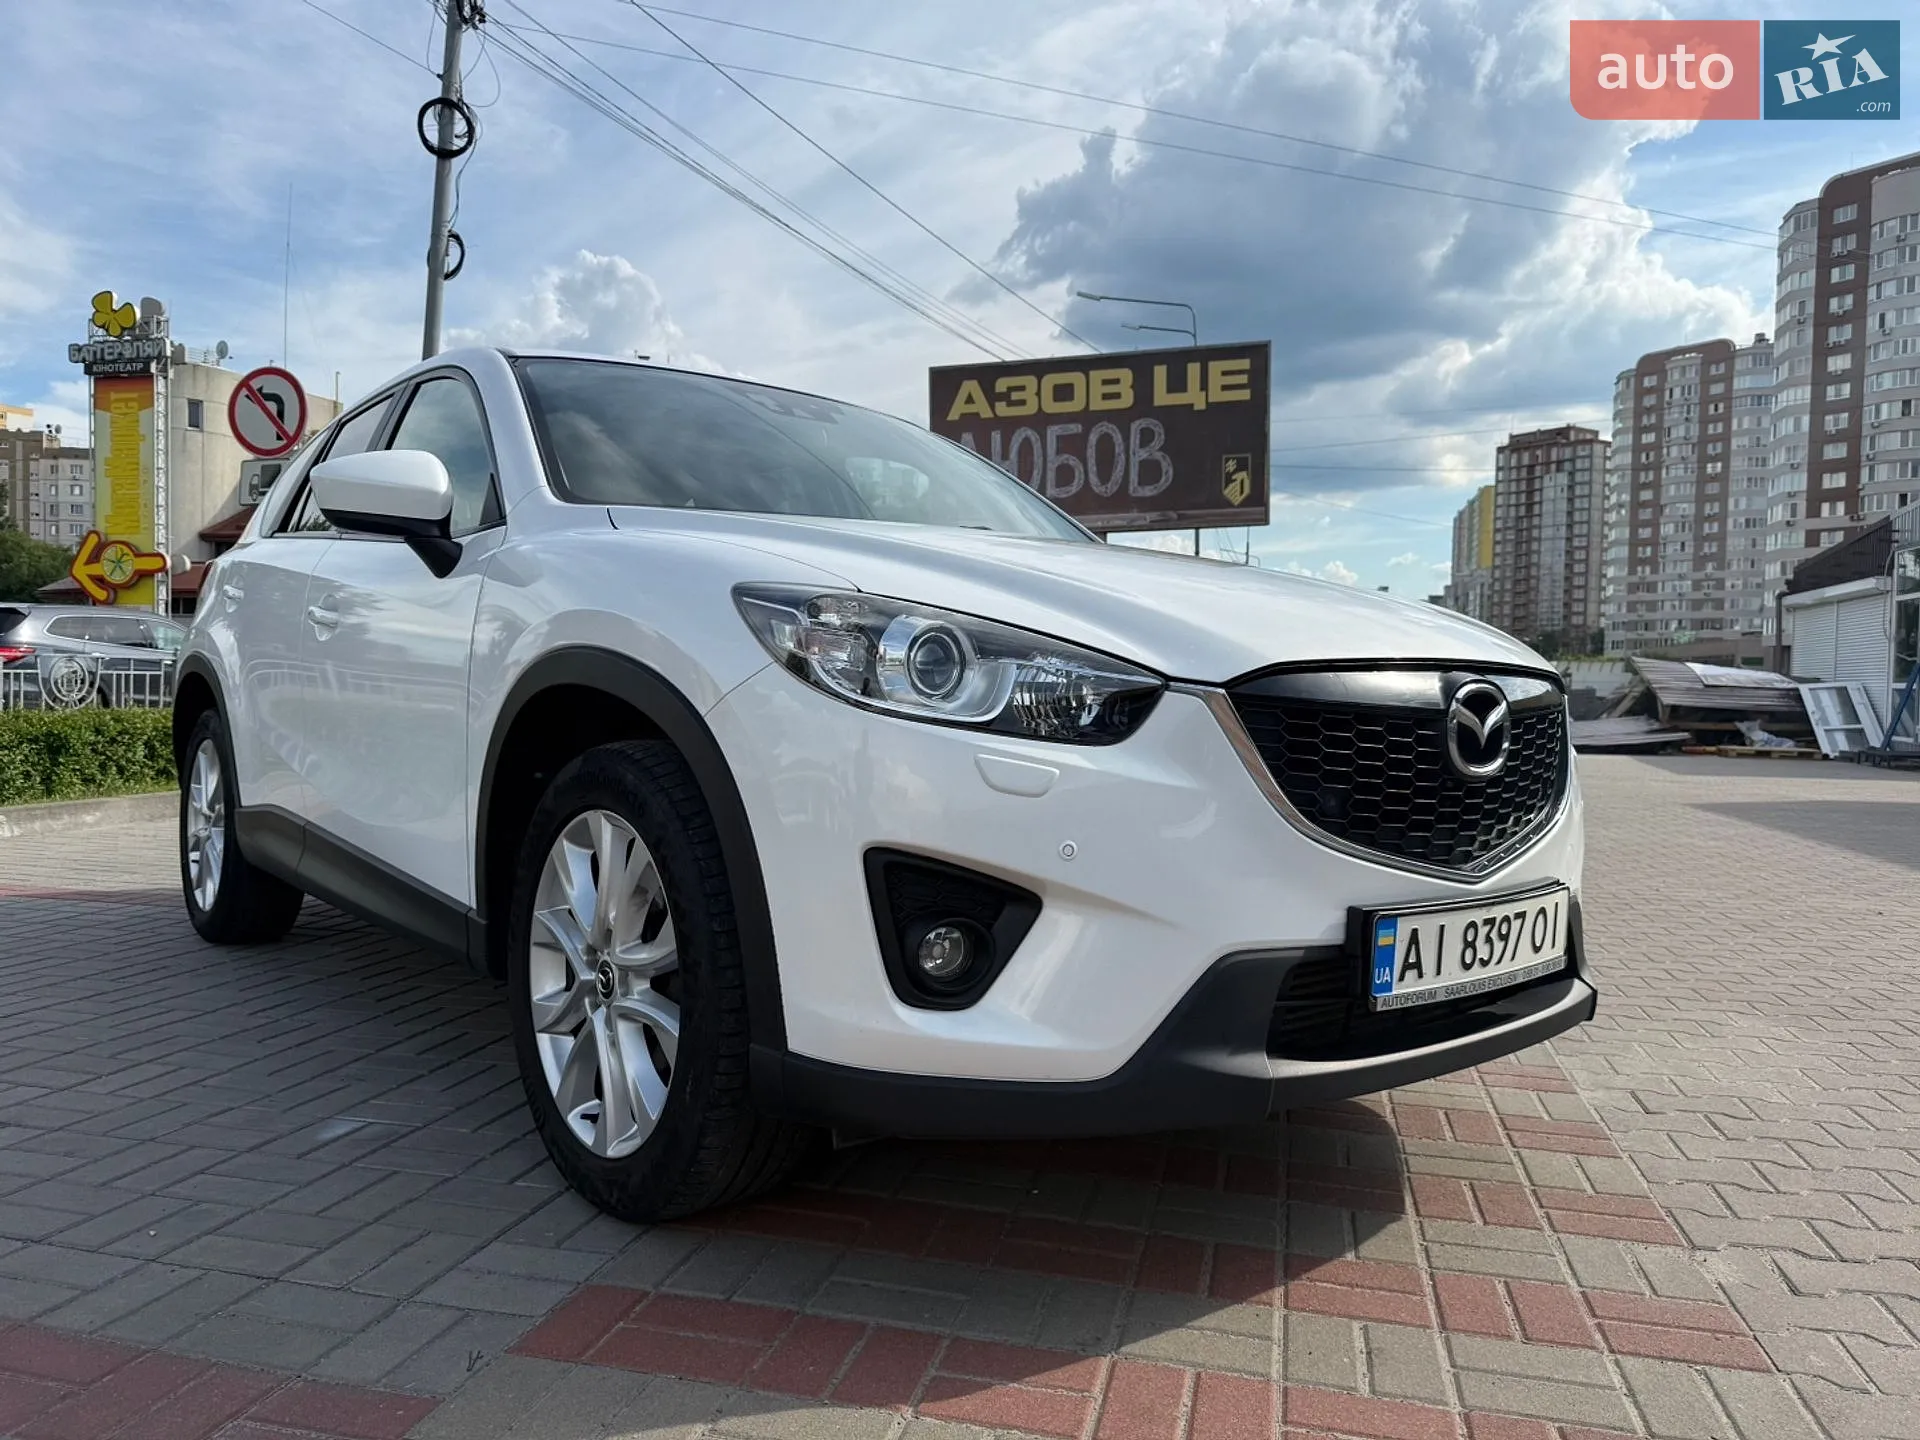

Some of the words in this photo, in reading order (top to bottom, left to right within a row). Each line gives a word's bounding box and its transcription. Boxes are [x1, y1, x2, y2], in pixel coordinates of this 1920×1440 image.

[92, 362, 144, 373] КІНОТЕАТР
[946, 367, 1134, 421] АЗОВ
[1153, 358, 1251, 411] ЦЕ
[1398, 924, 1446, 982] AI
[1461, 910, 1527, 971] 8397
[1374, 966, 1391, 984] UA
